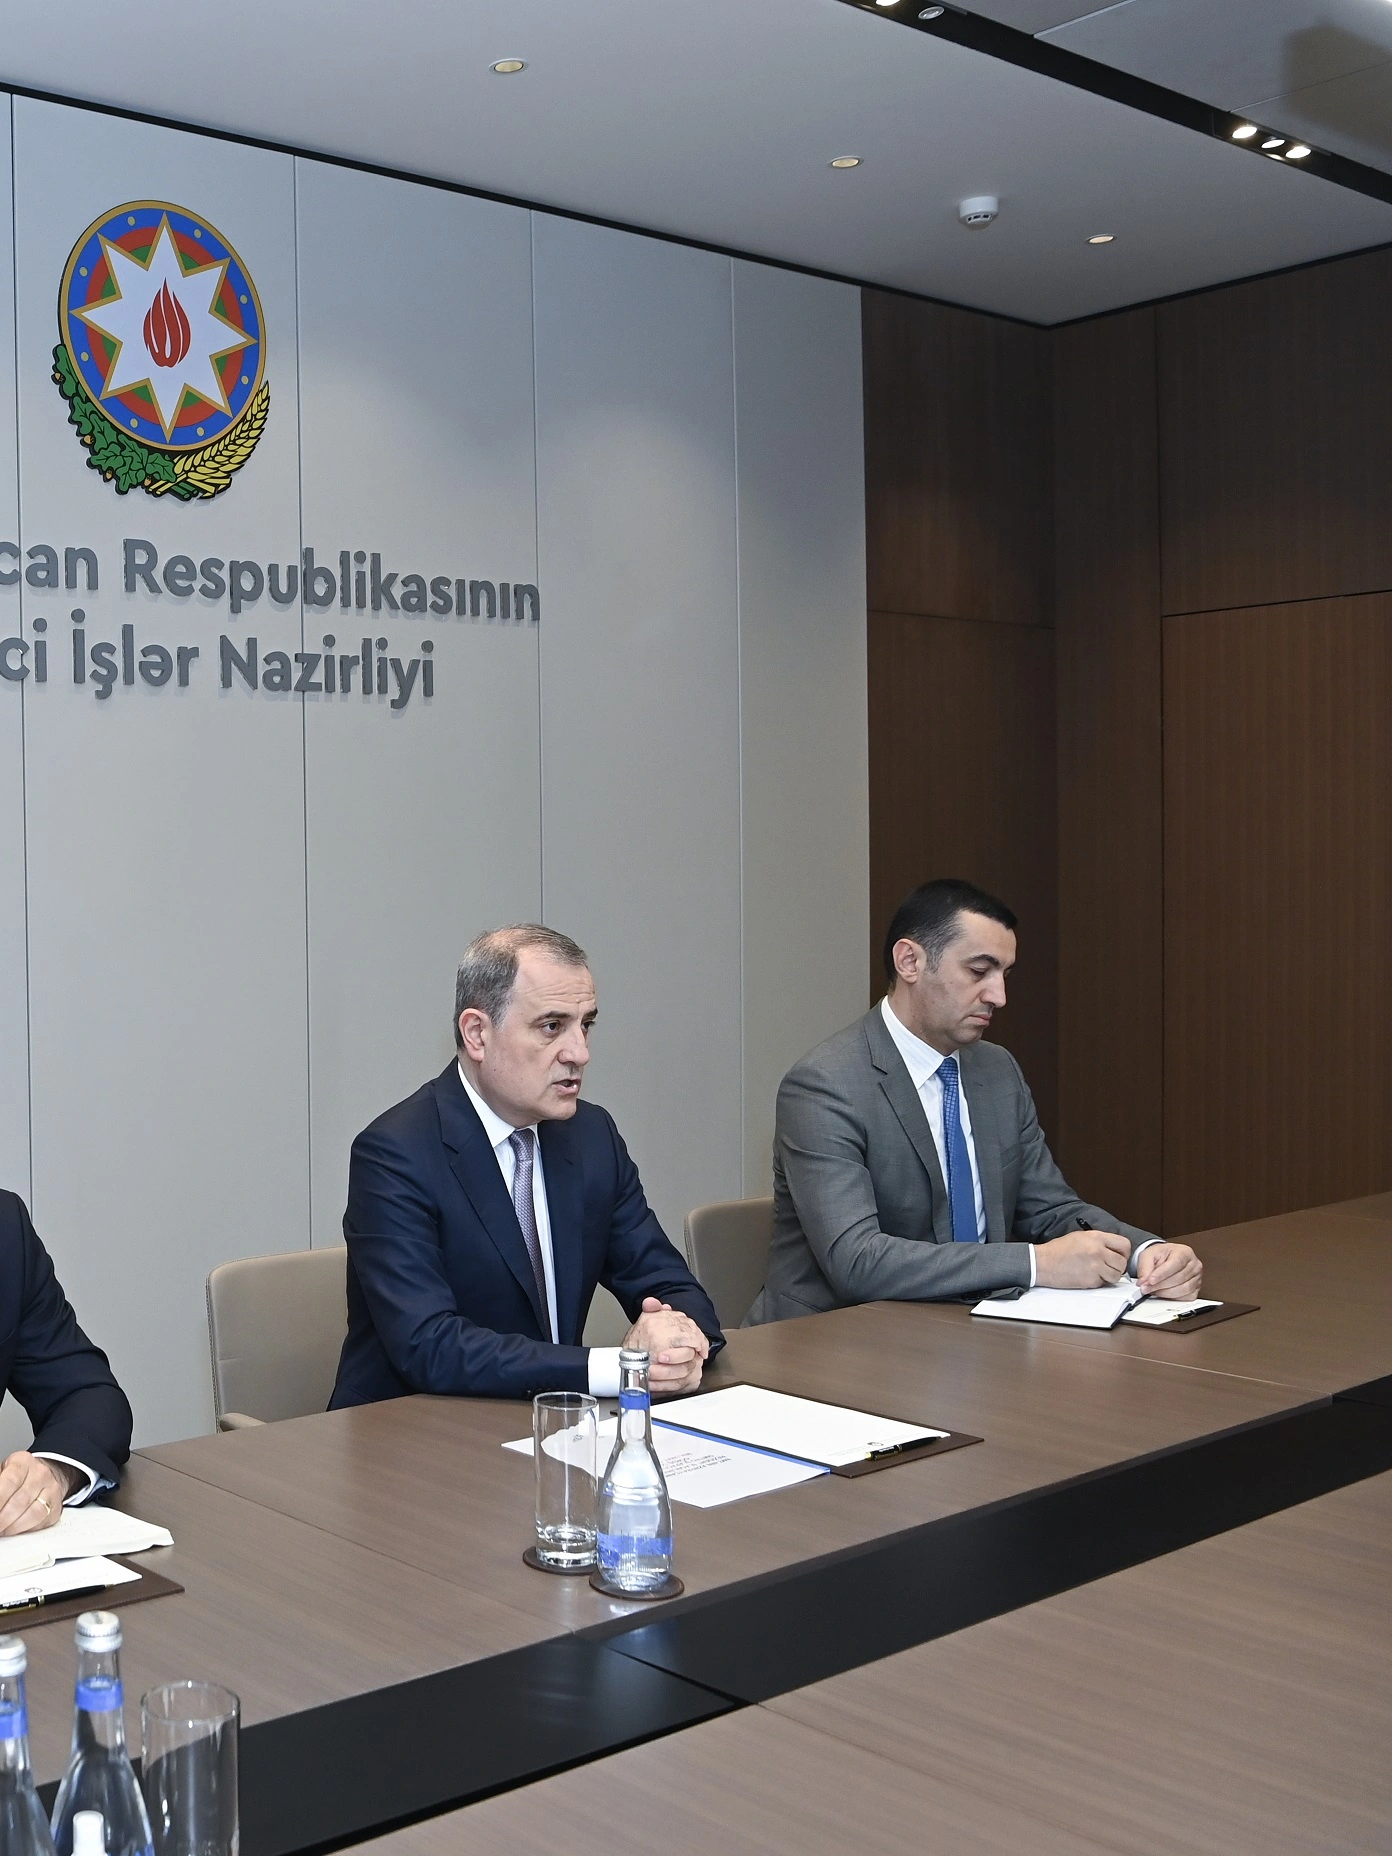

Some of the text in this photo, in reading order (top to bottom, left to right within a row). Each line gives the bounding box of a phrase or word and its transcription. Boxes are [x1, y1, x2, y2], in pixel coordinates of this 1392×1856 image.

[123, 538, 541, 621] Respublikasının
[72, 608, 201, 699] İşlər
[219, 634, 435, 709] Nazirliyi
